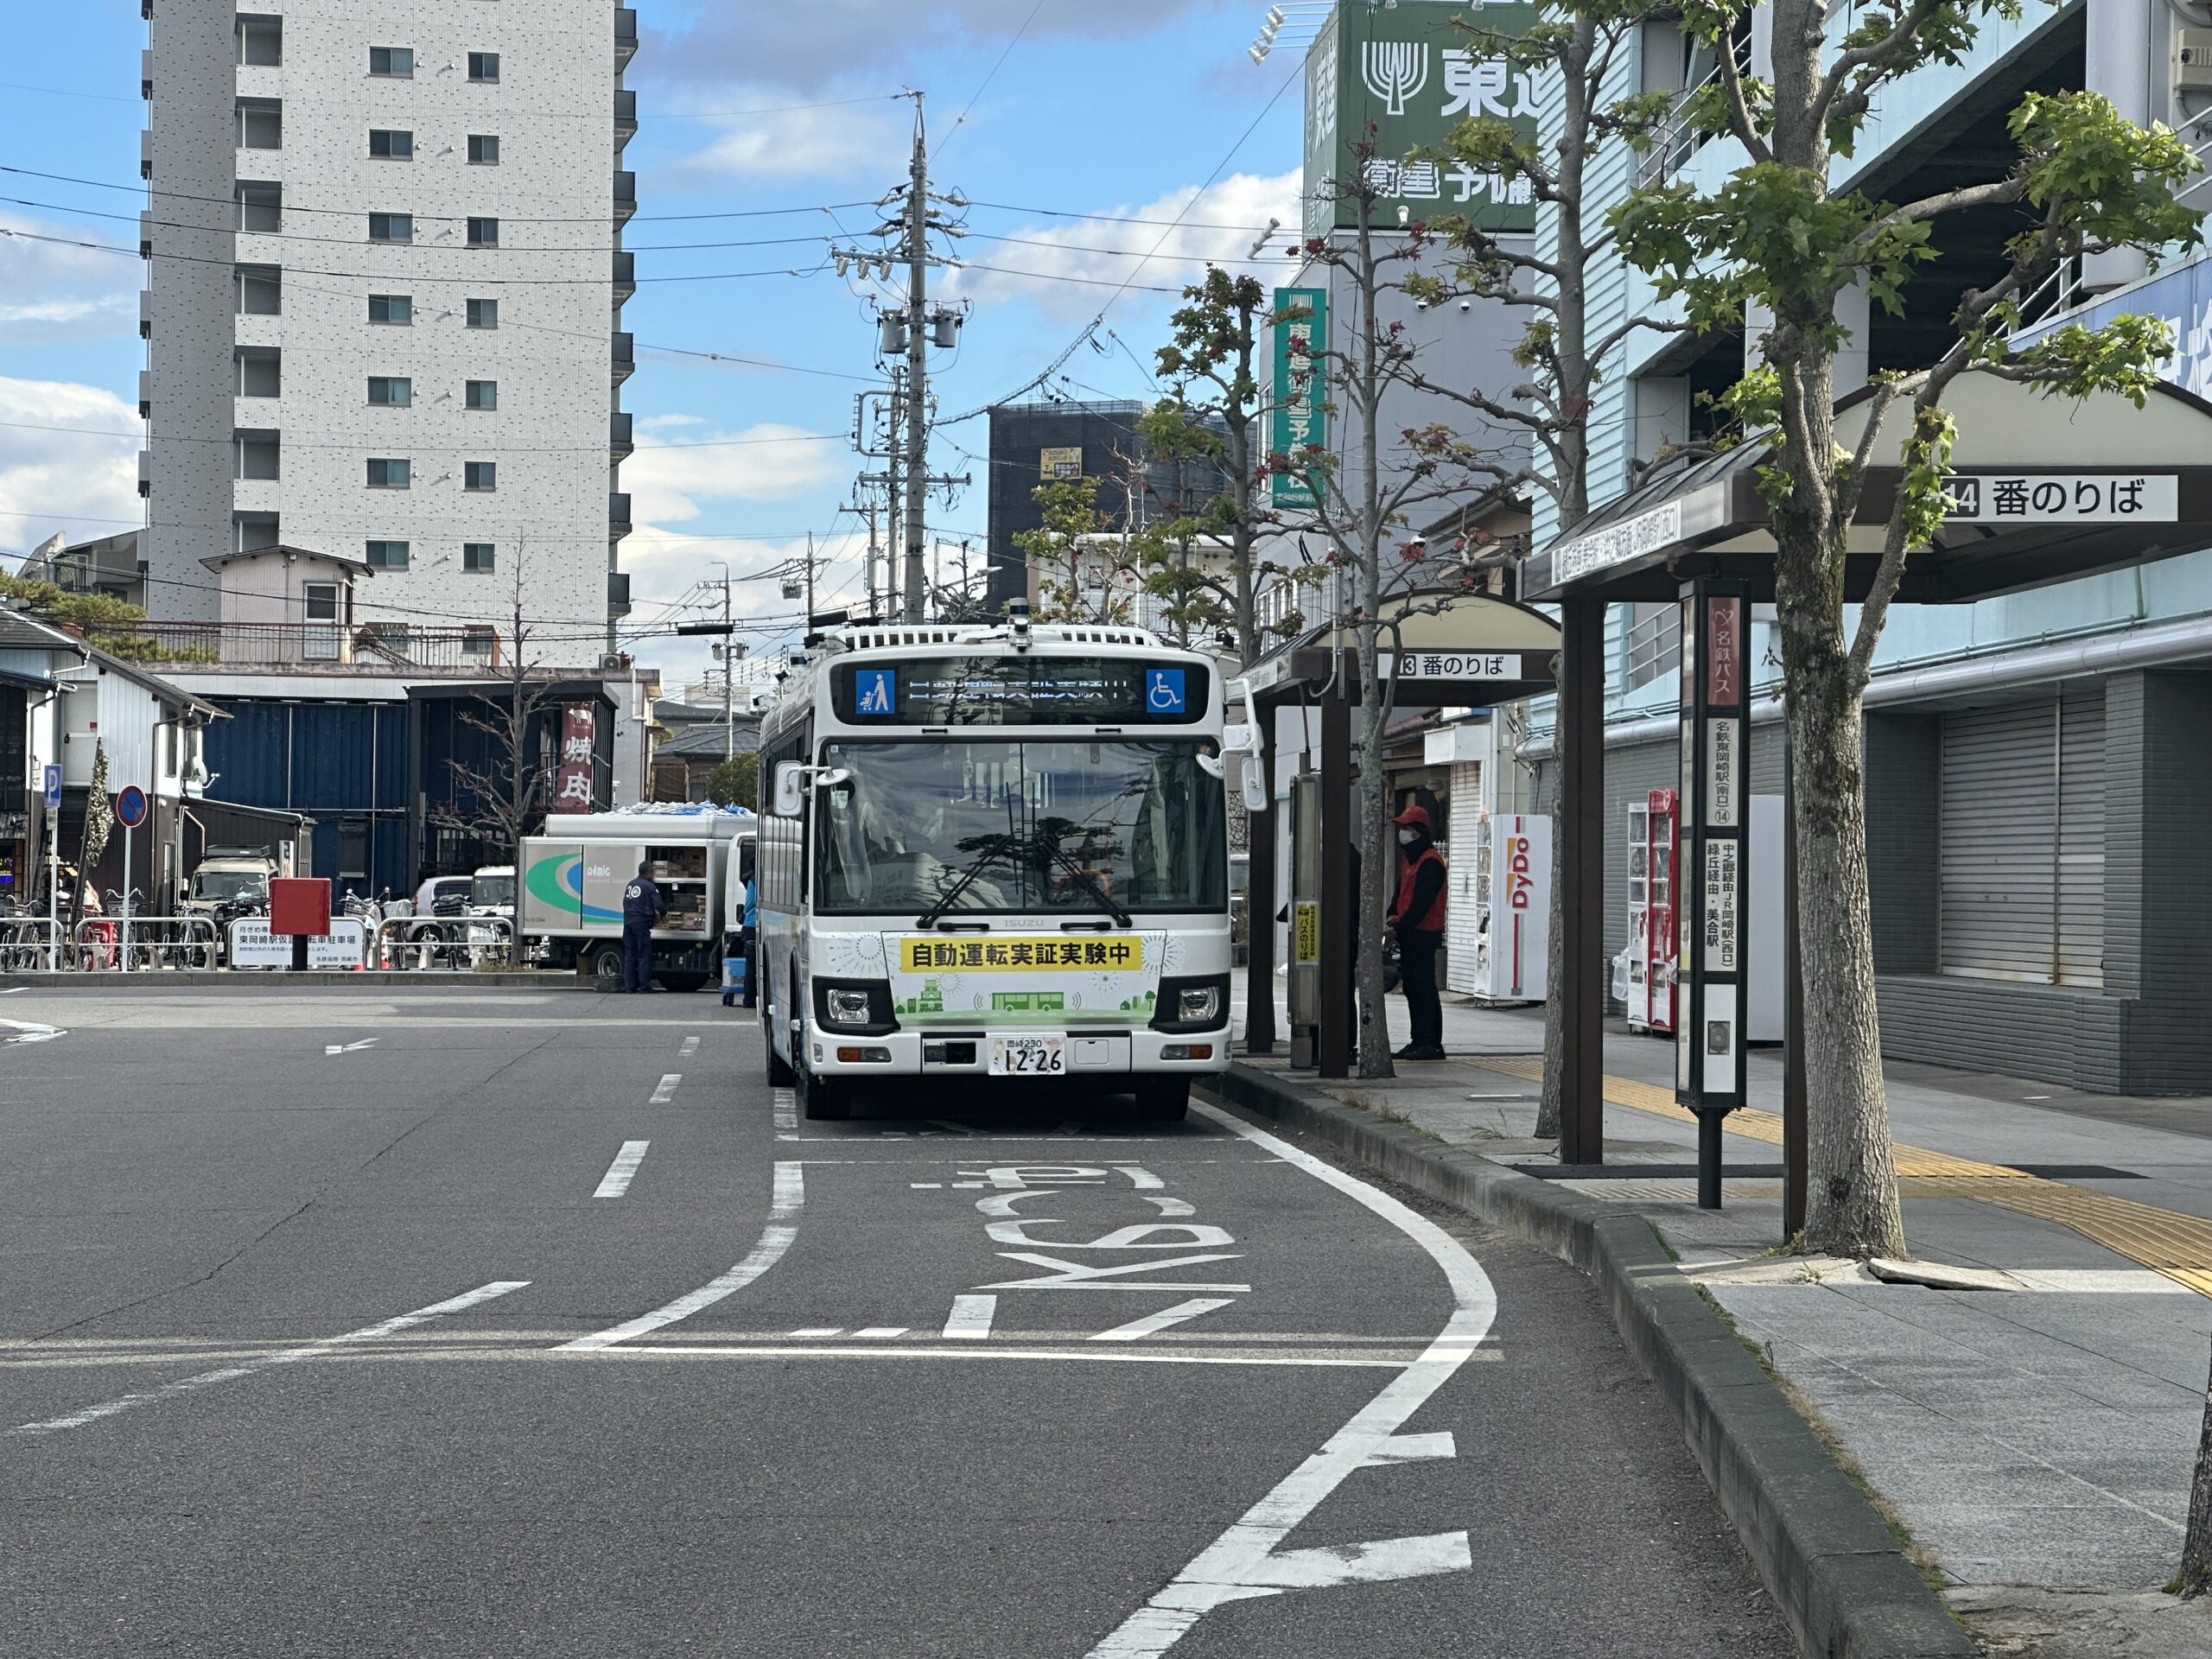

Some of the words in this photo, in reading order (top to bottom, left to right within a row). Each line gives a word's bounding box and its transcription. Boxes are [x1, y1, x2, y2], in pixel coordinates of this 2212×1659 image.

[1992, 478, 2145, 516] 番のりば
[1422, 655, 1504, 676] 番のりば
[1715, 631, 1732, 693] 名鉄バス
[48, 769, 58, 803] P
[561, 736, 592, 805] 焼肉
[1512, 837, 1534, 908] DyDo
[912, 943, 1130, 967] 自動運転実証実験中
[1005, 1049, 1062, 1071] 12-26
